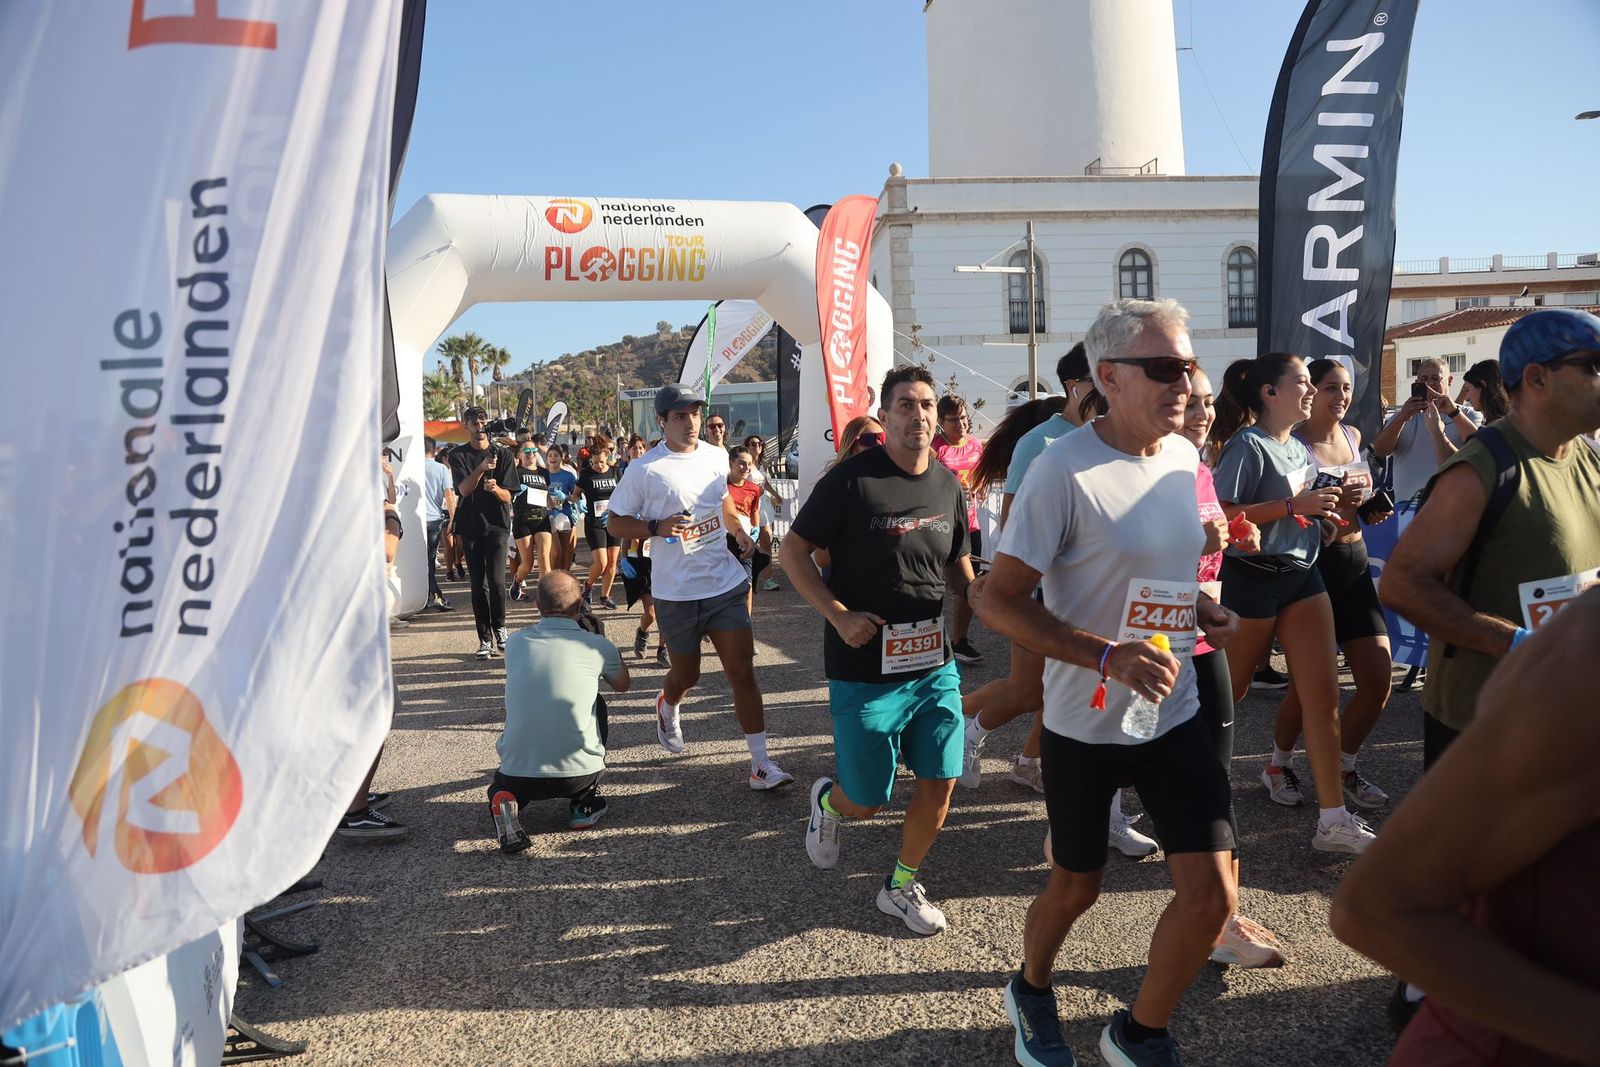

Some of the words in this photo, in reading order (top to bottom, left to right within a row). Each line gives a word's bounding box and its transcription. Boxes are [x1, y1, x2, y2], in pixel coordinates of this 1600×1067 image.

[600, 202, 676, 213] nationale
[602, 213, 705, 227] nederlanden
[665, 235, 705, 247] TOUR
[544, 245, 706, 282] PLOGGING
[829, 237, 860, 405] PLOGGING
[170, 176, 229, 637] nederlanden
[101, 307, 163, 638] nationale
[686, 518, 719, 540] 24376
[870, 517, 917, 530] NIKE
[918, 519, 951, 534] PRO
[1130, 605, 1194, 628] 24400
[892, 634, 937, 654] 24391
